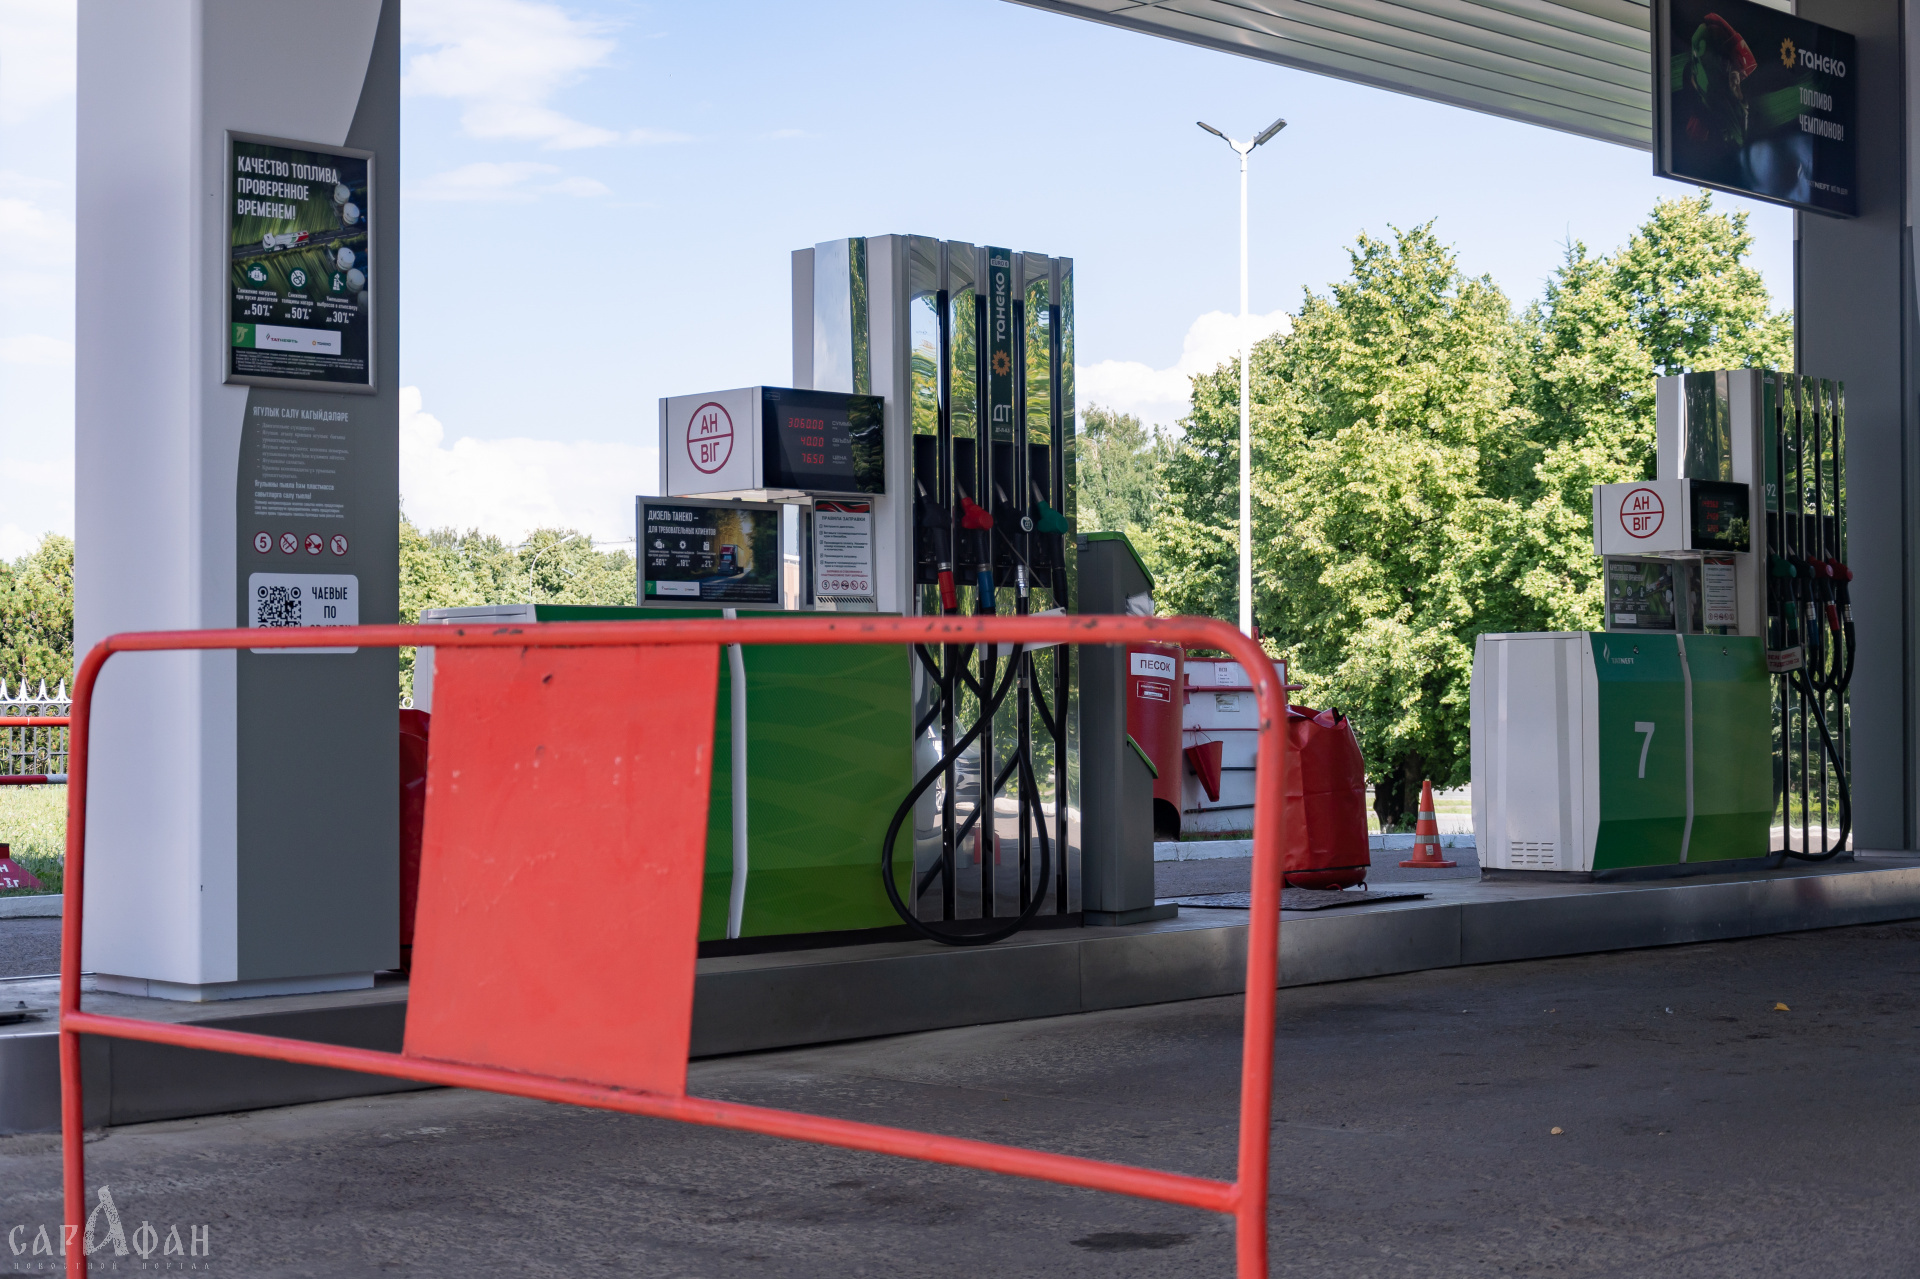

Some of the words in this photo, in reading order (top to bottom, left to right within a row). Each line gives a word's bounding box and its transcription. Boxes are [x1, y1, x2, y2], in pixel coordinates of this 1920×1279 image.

[1799, 87, 1833, 112] ТОПЛИВО
[1799, 113, 1844, 142] ЧЕМПИОНОВ!
[238, 156, 289, 177] КАЧЕСТВО
[291, 163, 341, 185] ТОПЛИВА,
[238, 178, 309, 201] ПРОВЕРЕННОЕ
[238, 199, 296, 220] ВРЕМЕНЕМ!
[253, 406, 279, 417] ЯГУЛЫК
[281, 409, 299, 419] САЛУ
[993, 404, 1012, 422] ДТ
[701, 413, 719, 435] АН
[1767, 484, 1776, 497] 92
[1633, 496, 1650, 511] АН
[648, 510, 671, 521] ДИЗЕЛЬ
[672, 511, 693, 522] ТАНЕКО
[648, 526, 658, 534] ДЛЯ
[658, 526, 695, 535] ТРЕБОВАТЕЛЬНЫХ
[695, 528, 717, 536] КЛИЕНТОВ
[259, 536, 267, 549] 5
[312, 587, 348, 600] ЧАЕВЫЕ
[323, 605, 337, 619] ПО
[1140, 659, 1171, 673] ПЕСОК
[1633, 721, 1656, 779] 7
